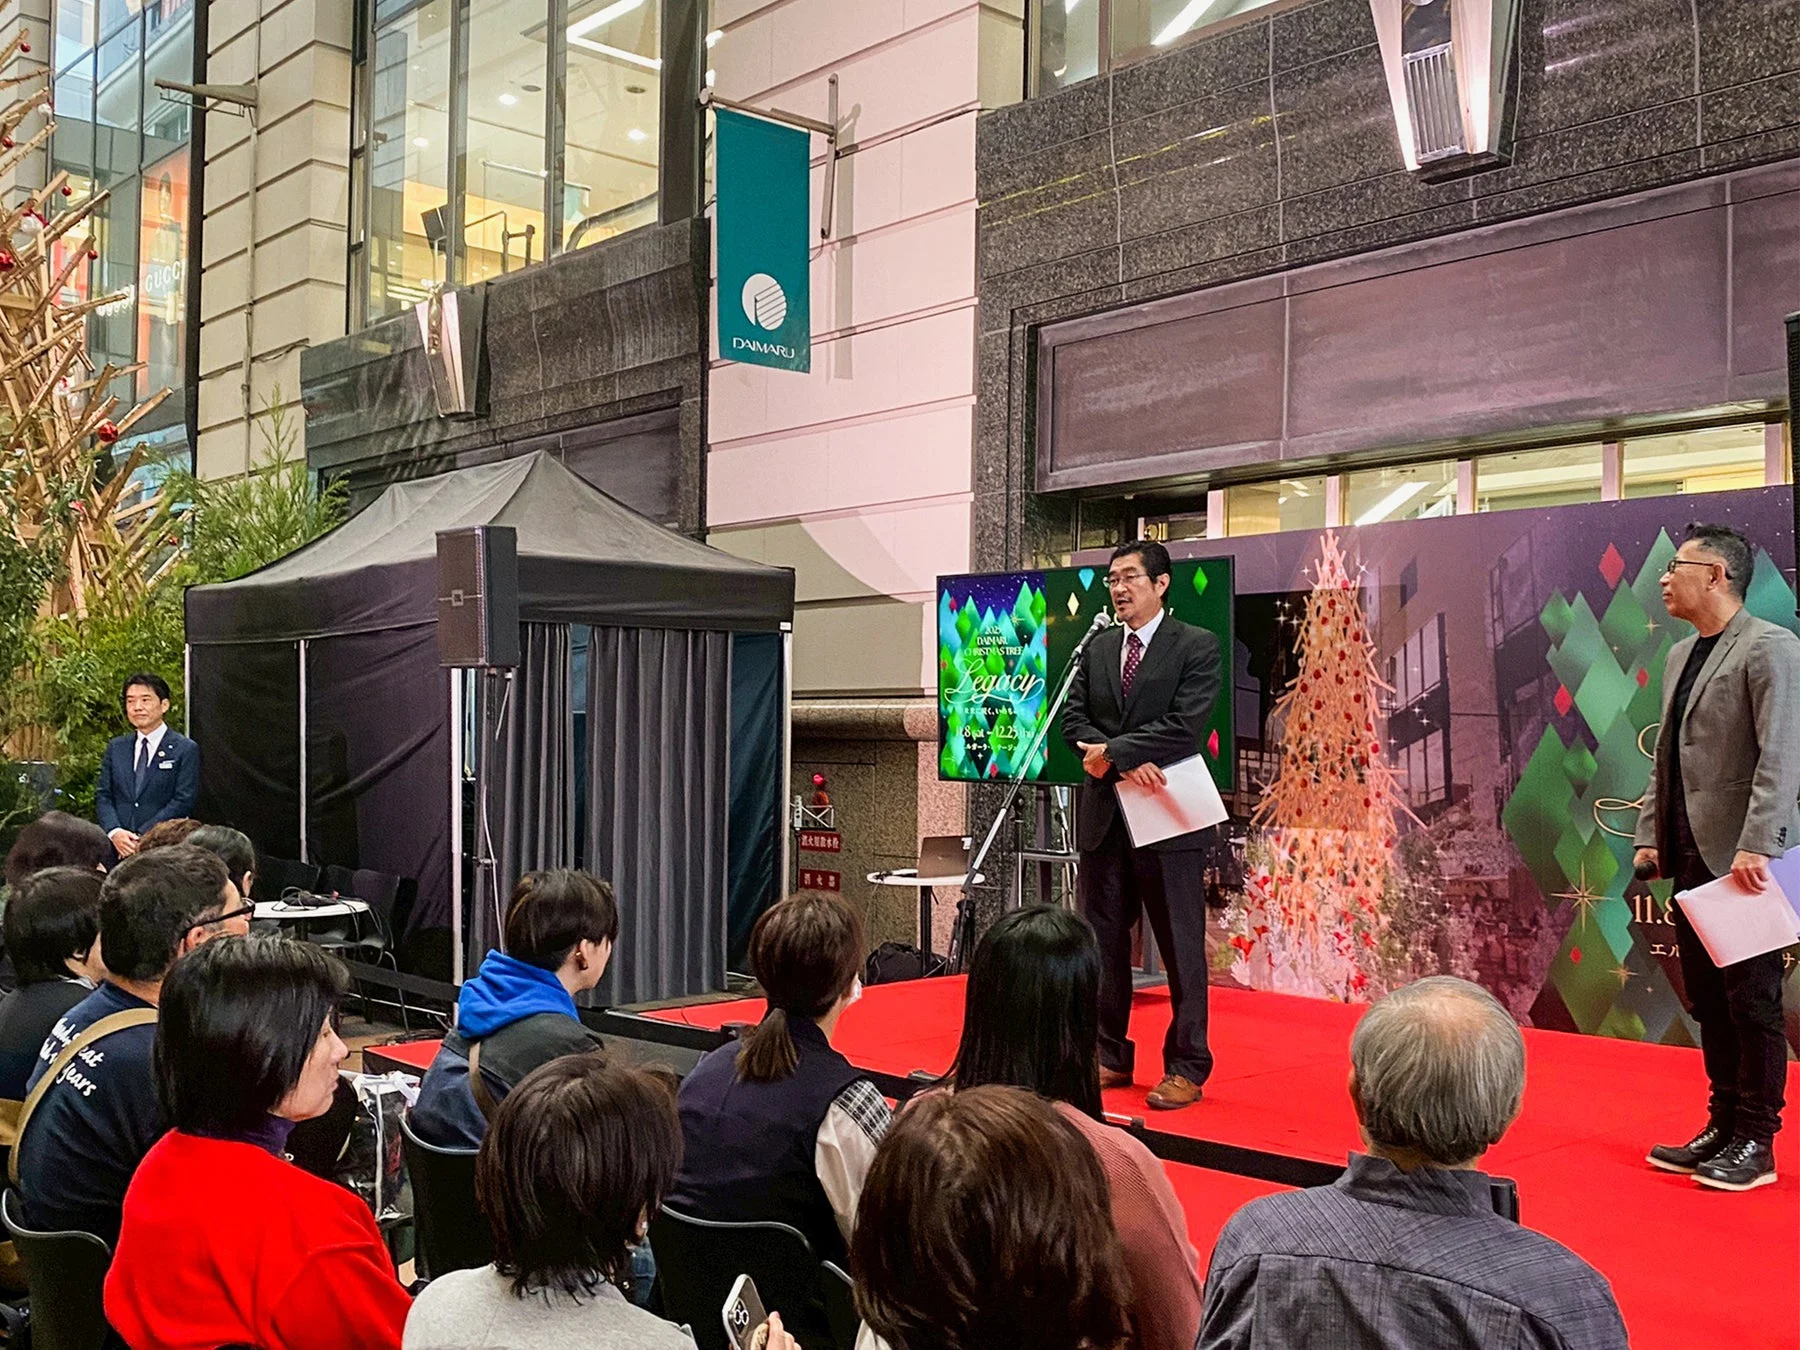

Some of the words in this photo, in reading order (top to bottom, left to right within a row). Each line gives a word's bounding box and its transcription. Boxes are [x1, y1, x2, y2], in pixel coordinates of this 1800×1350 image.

[145, 259, 186, 292] GUCCI
[732, 337, 795, 359] DAIMARU
[944, 658, 1046, 704] Legacy
